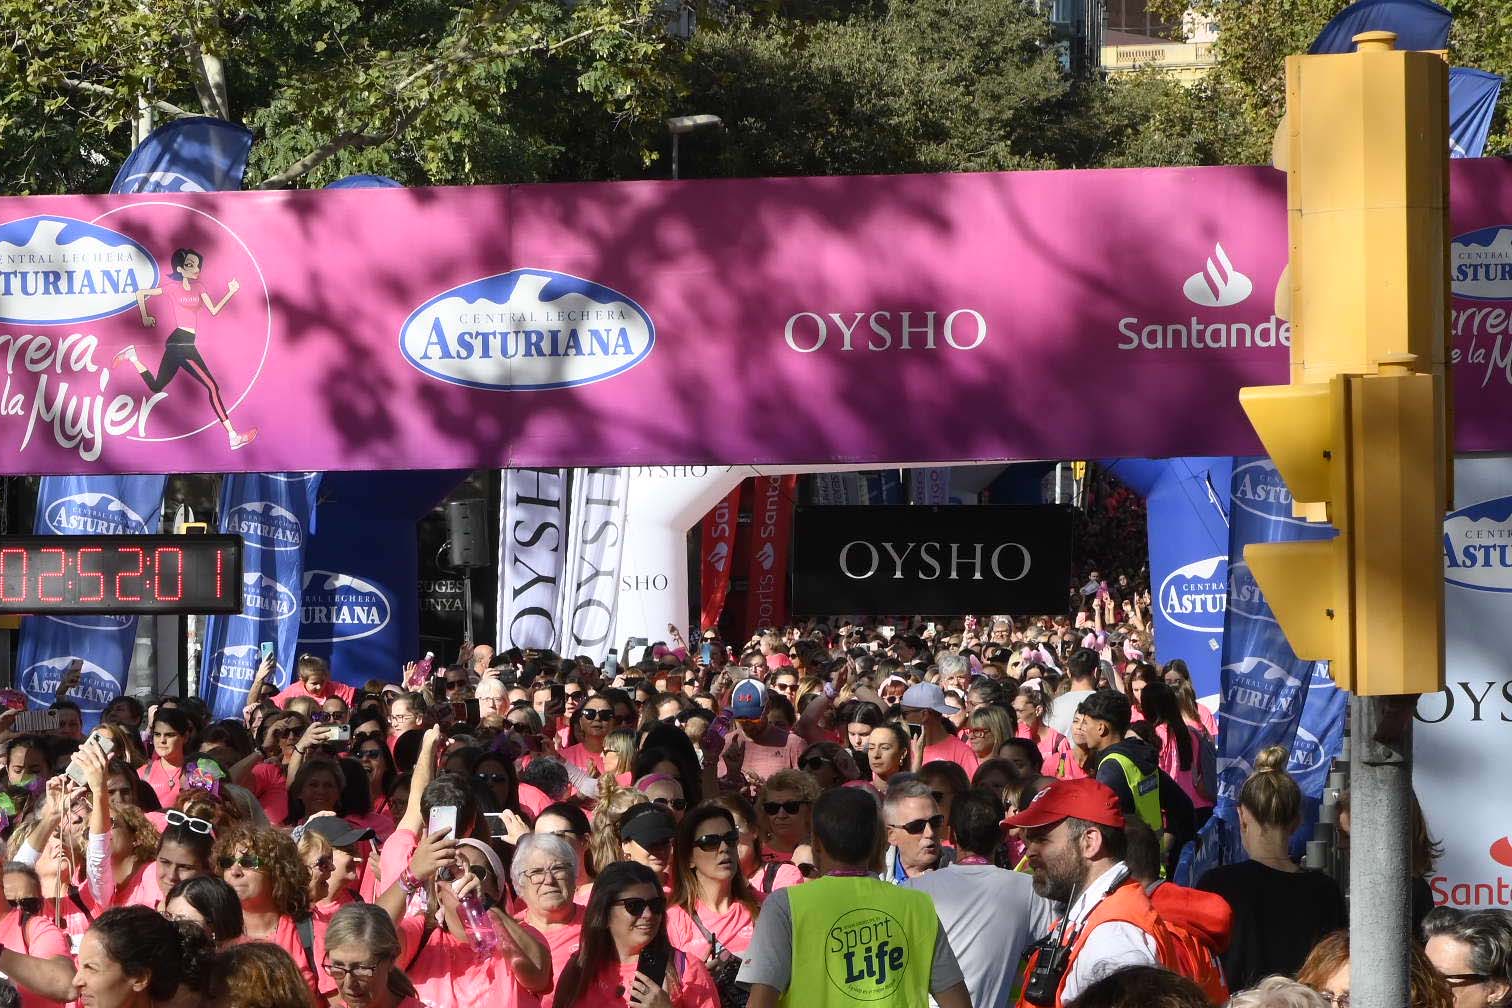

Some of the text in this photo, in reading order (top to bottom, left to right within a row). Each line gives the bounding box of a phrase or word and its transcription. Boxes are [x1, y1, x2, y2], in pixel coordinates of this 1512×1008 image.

[61, 252, 136, 264] LECHERA
[459, 309, 627, 324] CENTRAL LECHERA
[784, 309, 988, 353] OYSHO
[1117, 315, 1291, 350] Santande
[419, 316, 635, 360] ASTURIANA
[0, 375, 25, 416] la
[19, 367, 169, 462] Mujer
[760, 474, 782, 539] Santa
[1235, 473, 1294, 504] ASTU
[0, 546, 222, 602] 02:52:01
[509, 467, 562, 650] OYSH
[571, 467, 622, 648] OYSH
[838, 540, 1032, 582] OYSHO
[621, 573, 669, 592] SHO
[1166, 584, 1226, 614] ASTU
[1182, 582, 1226, 591] CENTRA
[301, 606, 381, 625] URIANA
[831, 916, 893, 954] Sport
[843, 941, 904, 985] Life
